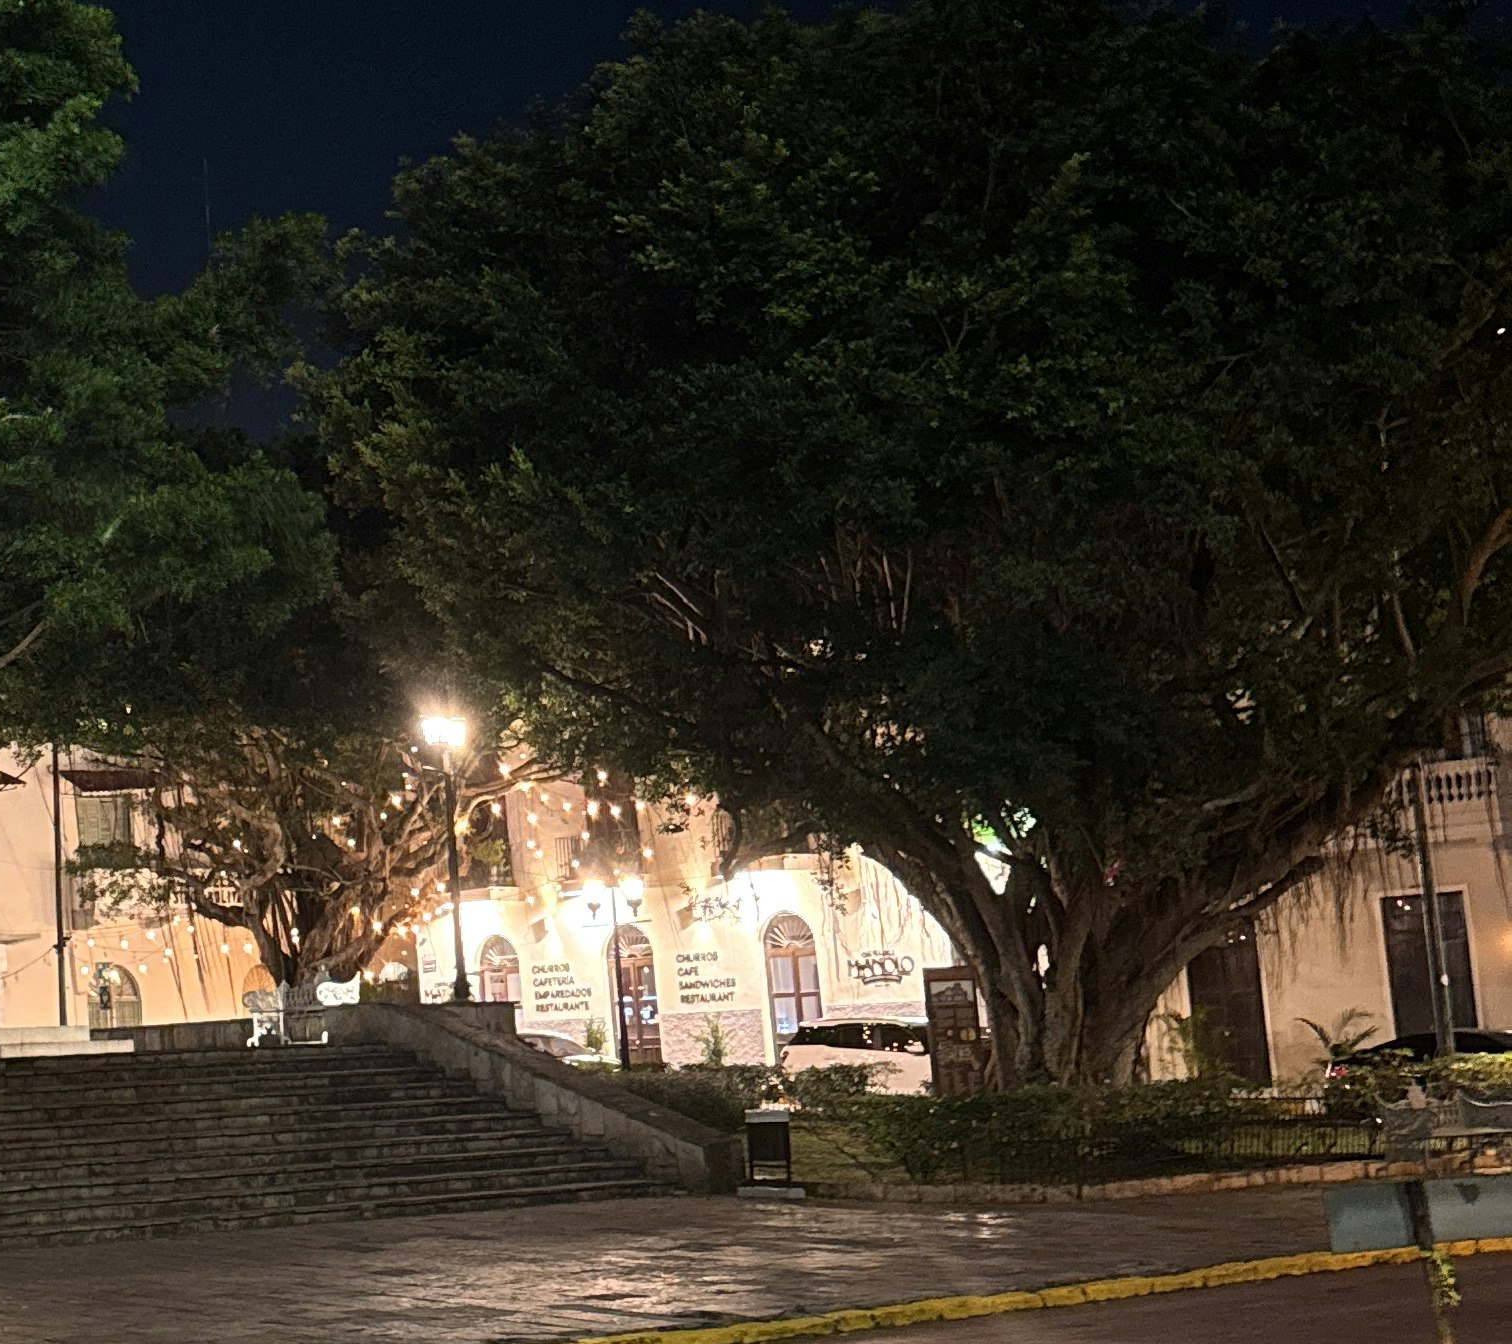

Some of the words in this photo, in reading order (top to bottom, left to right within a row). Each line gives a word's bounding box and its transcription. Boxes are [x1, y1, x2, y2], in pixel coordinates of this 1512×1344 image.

[678, 978, 736, 990] SANDWICHES
[680, 991, 735, 1004] RESTAURANT
[535, 1001, 590, 1012] RESTAURANTE
